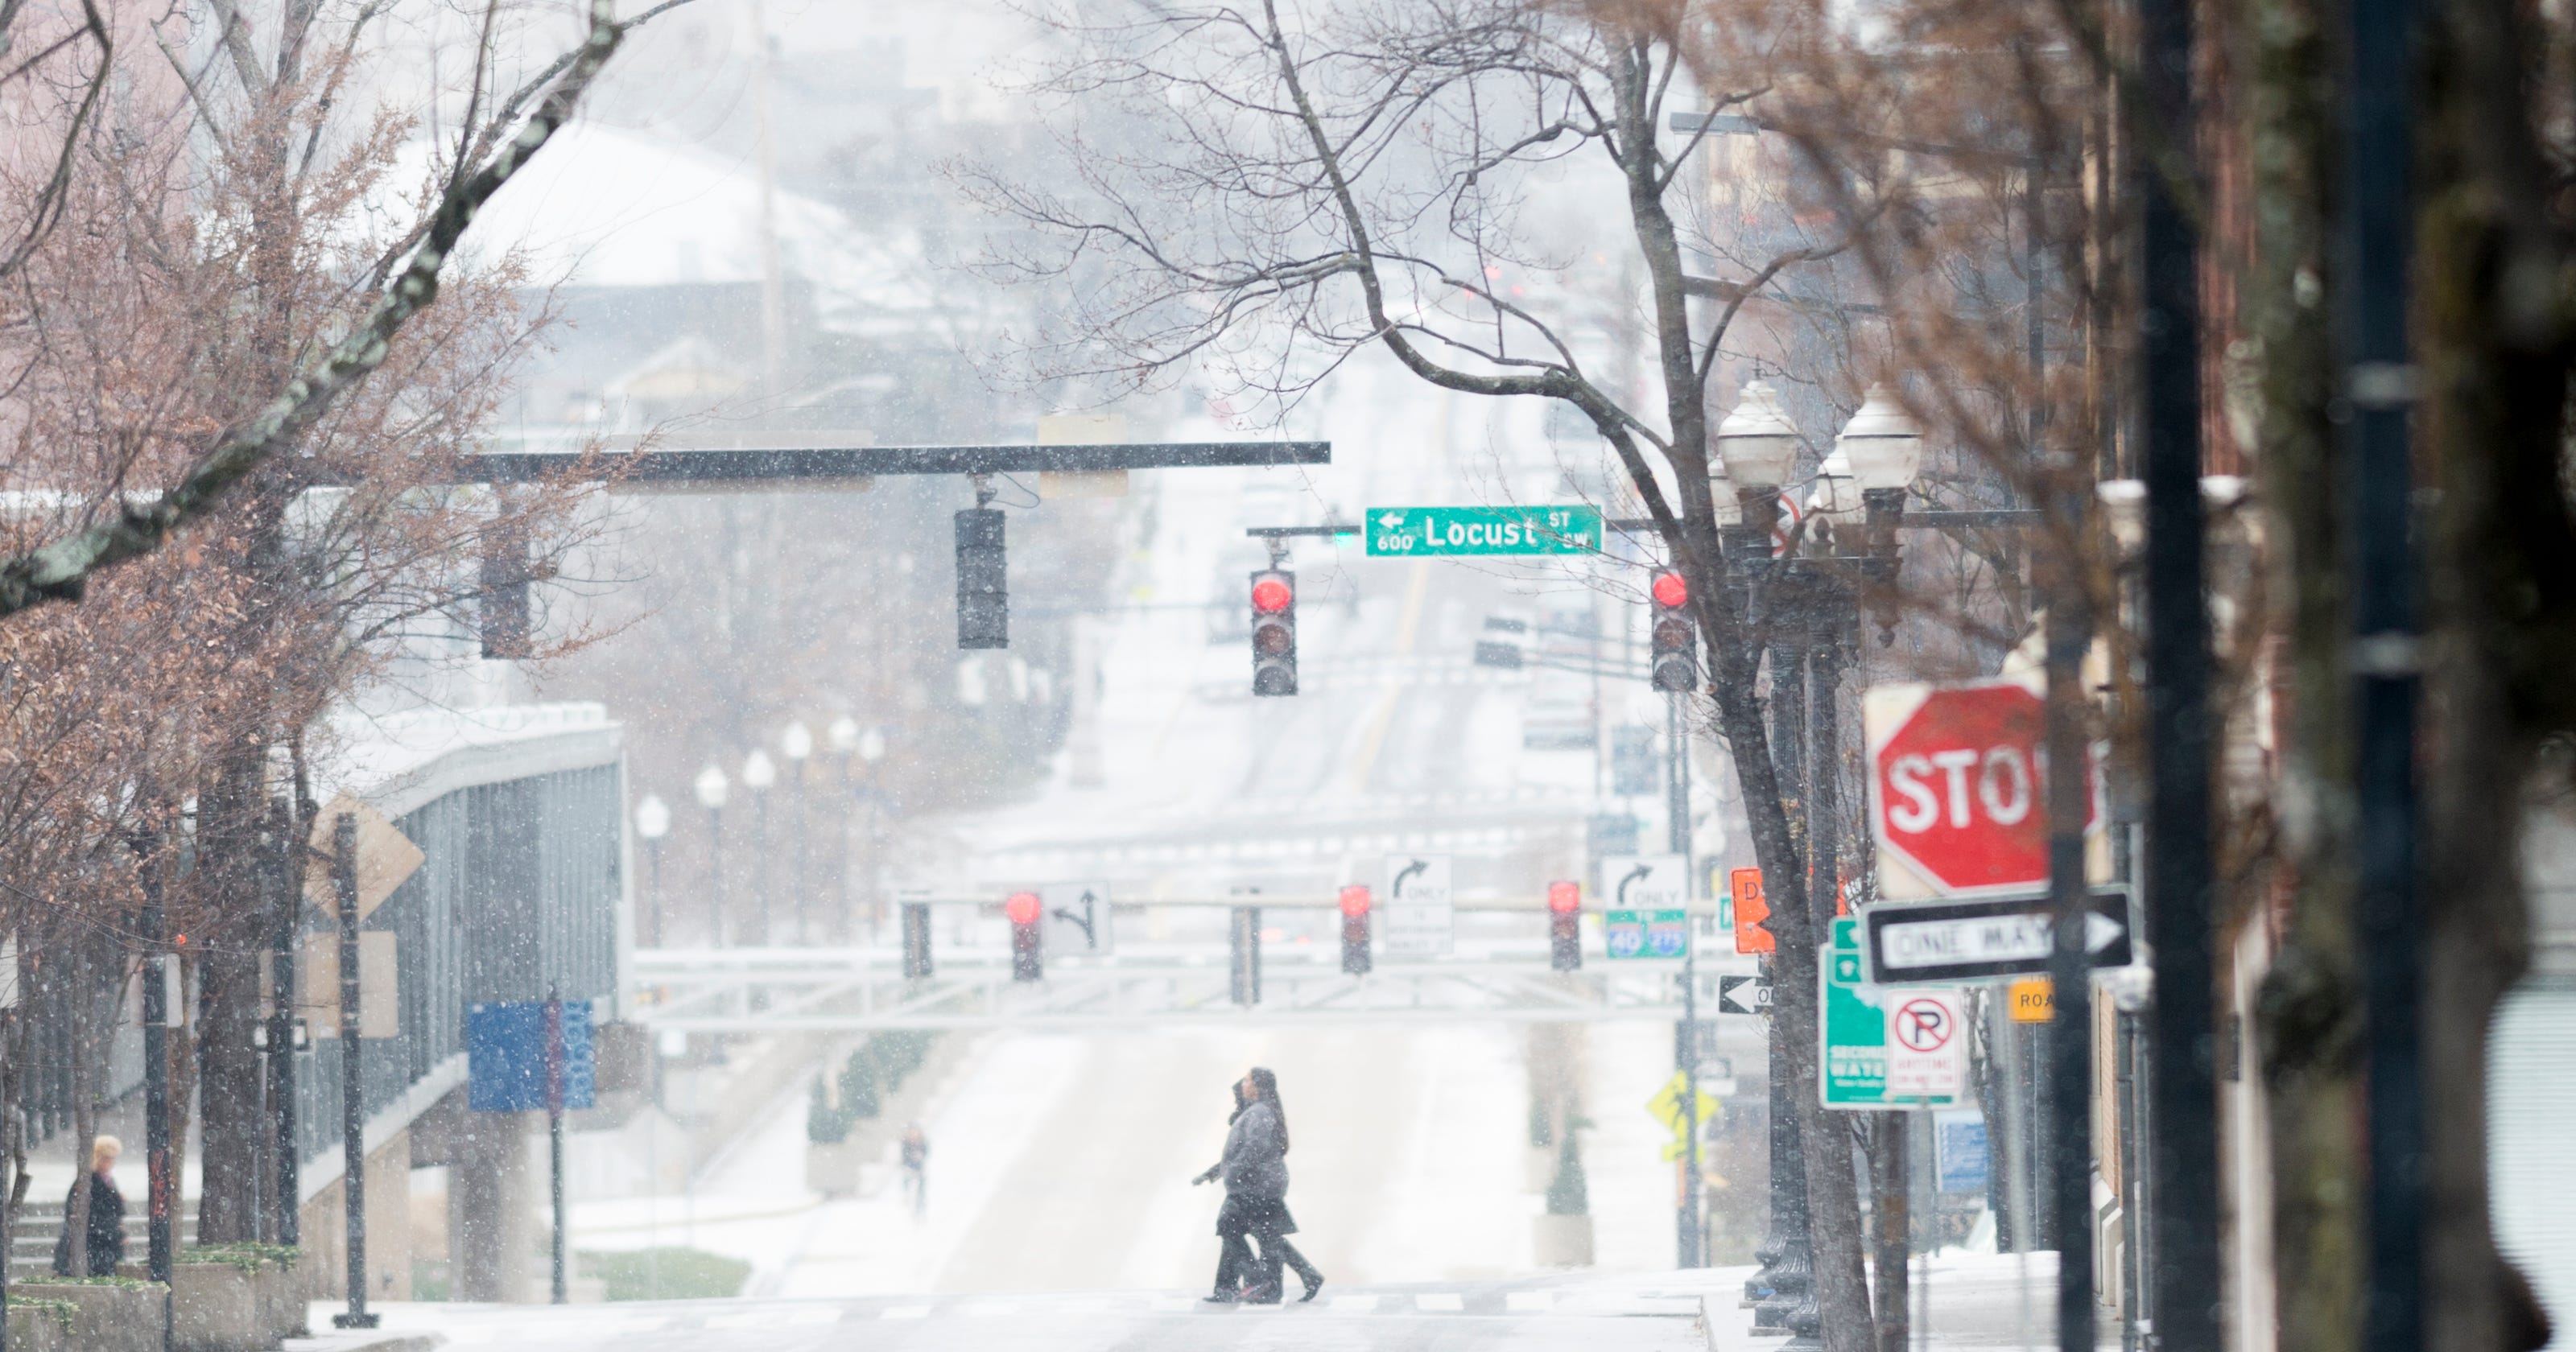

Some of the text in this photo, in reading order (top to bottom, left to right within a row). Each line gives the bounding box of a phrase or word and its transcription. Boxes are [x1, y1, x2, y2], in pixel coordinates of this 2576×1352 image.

[1426, 513, 1570, 546] Locust ST
[1377, 535, 1414, 551] 600
[1888, 741, 2050, 834] STO
[1894, 919, 2054, 957] ONE WAY
[2020, 993, 2055, 1008] ROA
[1829, 1061, 1885, 1078] WATE
